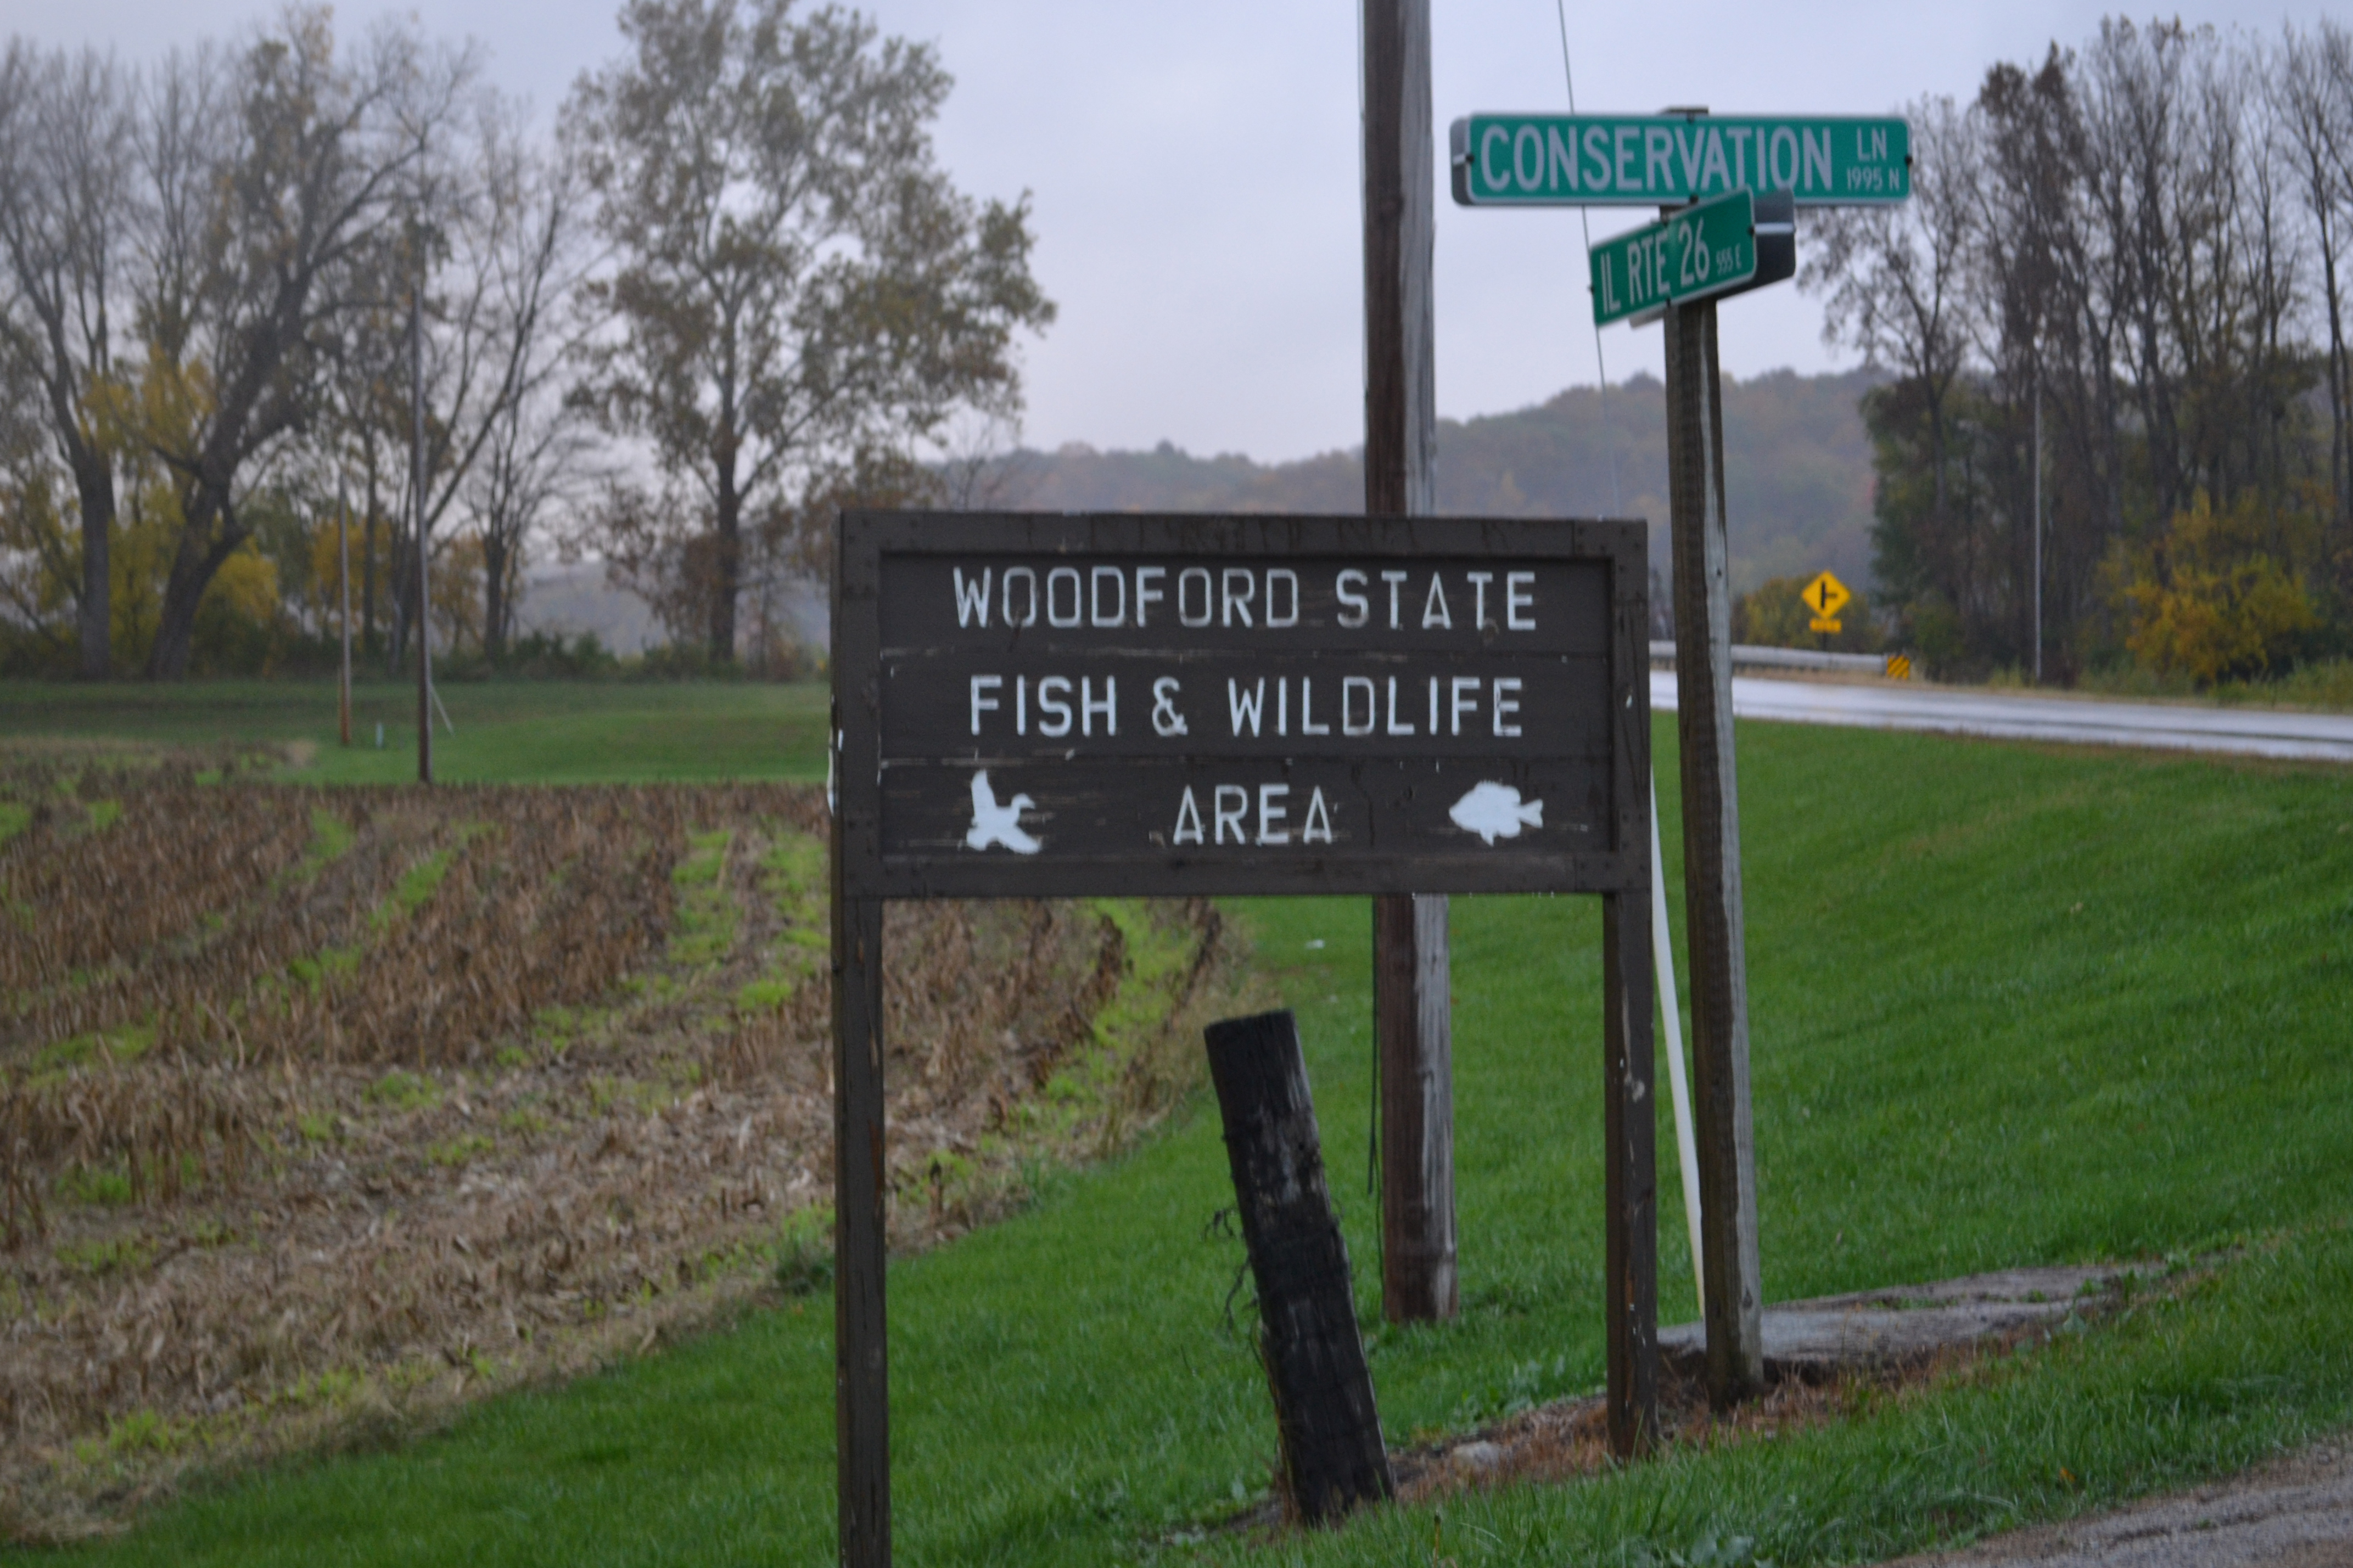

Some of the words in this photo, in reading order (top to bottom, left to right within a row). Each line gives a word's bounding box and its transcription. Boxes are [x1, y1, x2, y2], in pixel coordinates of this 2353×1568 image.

[1481, 124, 1832, 192] CONSERVATION
[1857, 127, 1887, 162] LN
[1847, 166, 1883, 192] 1995
[1889, 167, 1900, 190] N
[1600, 250, 1621, 314] IL
[1627, 229, 1670, 305] RTE
[1678, 216, 1710, 287] 26
[953, 566, 1298, 627] WOODFORD
[1336, 570, 1537, 630] STATE
[970, 675, 1117, 737] FISH
[1151, 676, 1189, 737] &
[1228, 677, 1523, 737] WILDLIFE
[1173, 784, 1333, 845] AREA
